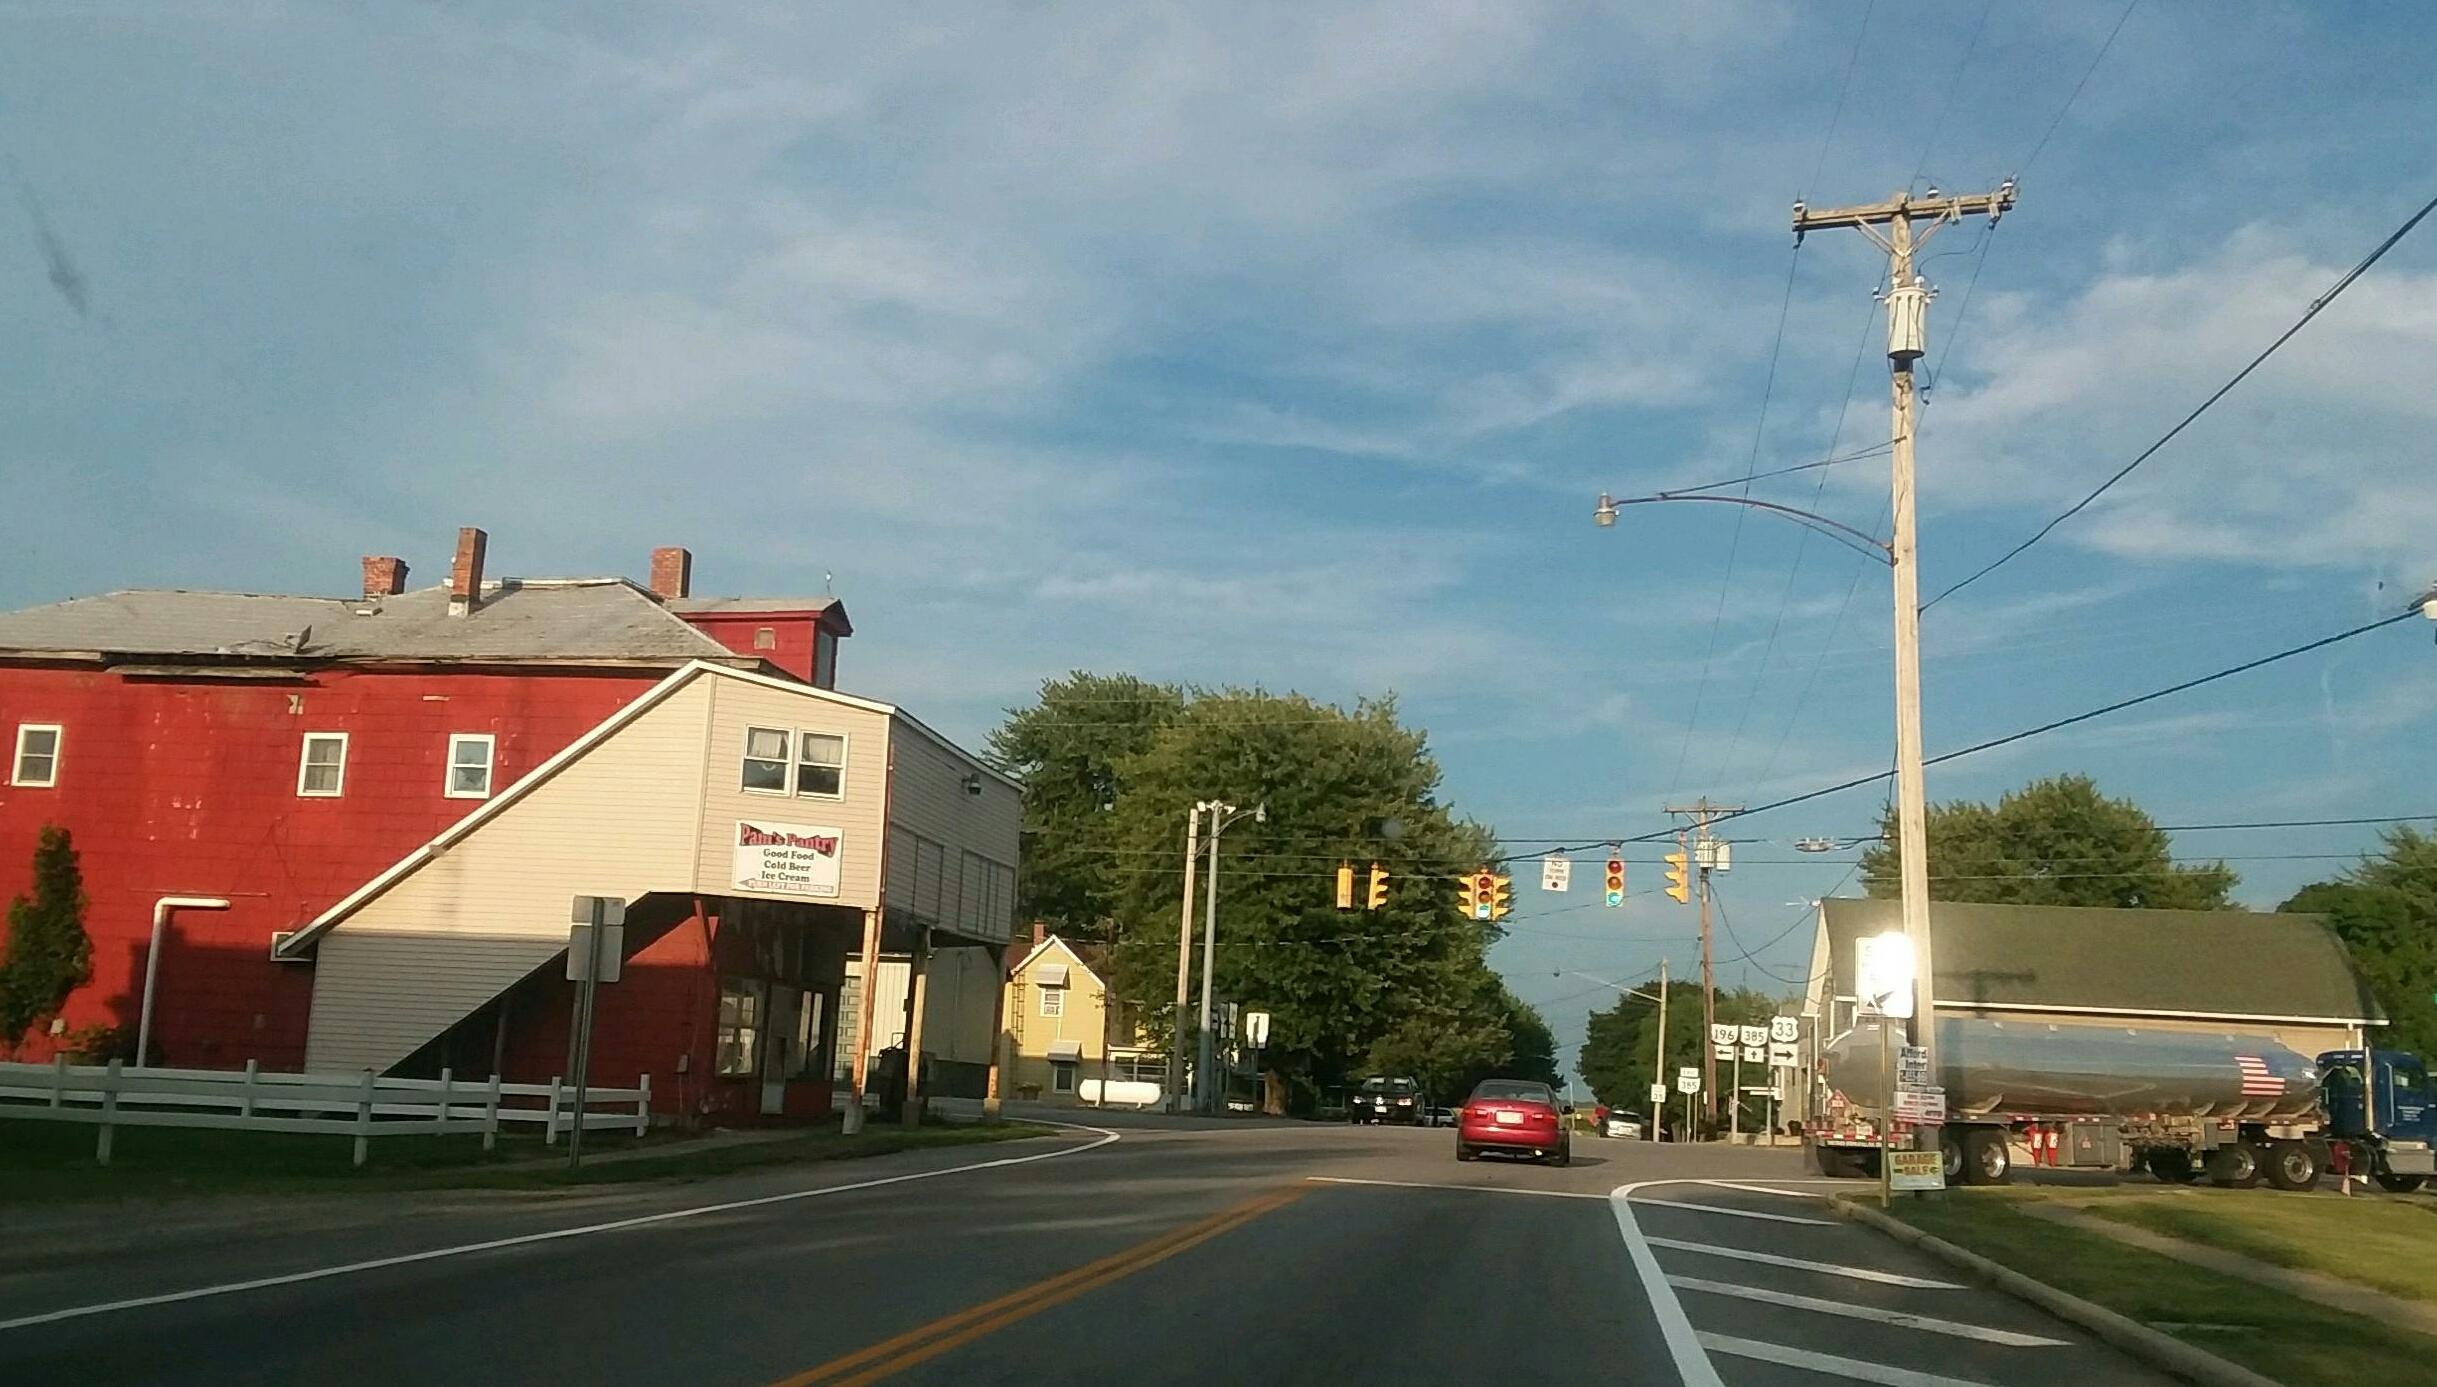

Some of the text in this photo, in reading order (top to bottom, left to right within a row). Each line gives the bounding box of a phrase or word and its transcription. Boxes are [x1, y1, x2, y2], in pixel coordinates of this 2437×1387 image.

[740, 823, 839, 858] Pam's Pantry
[763, 848, 814, 860] Good Food
[764, 860, 811, 872] Cold Beer
[761, 871, 810, 882] Ice Cream
[1715, 1029, 1734, 1040] 196
[1776, 1022, 1793, 1037] 33
[1745, 1031, 1764, 1042] 385
